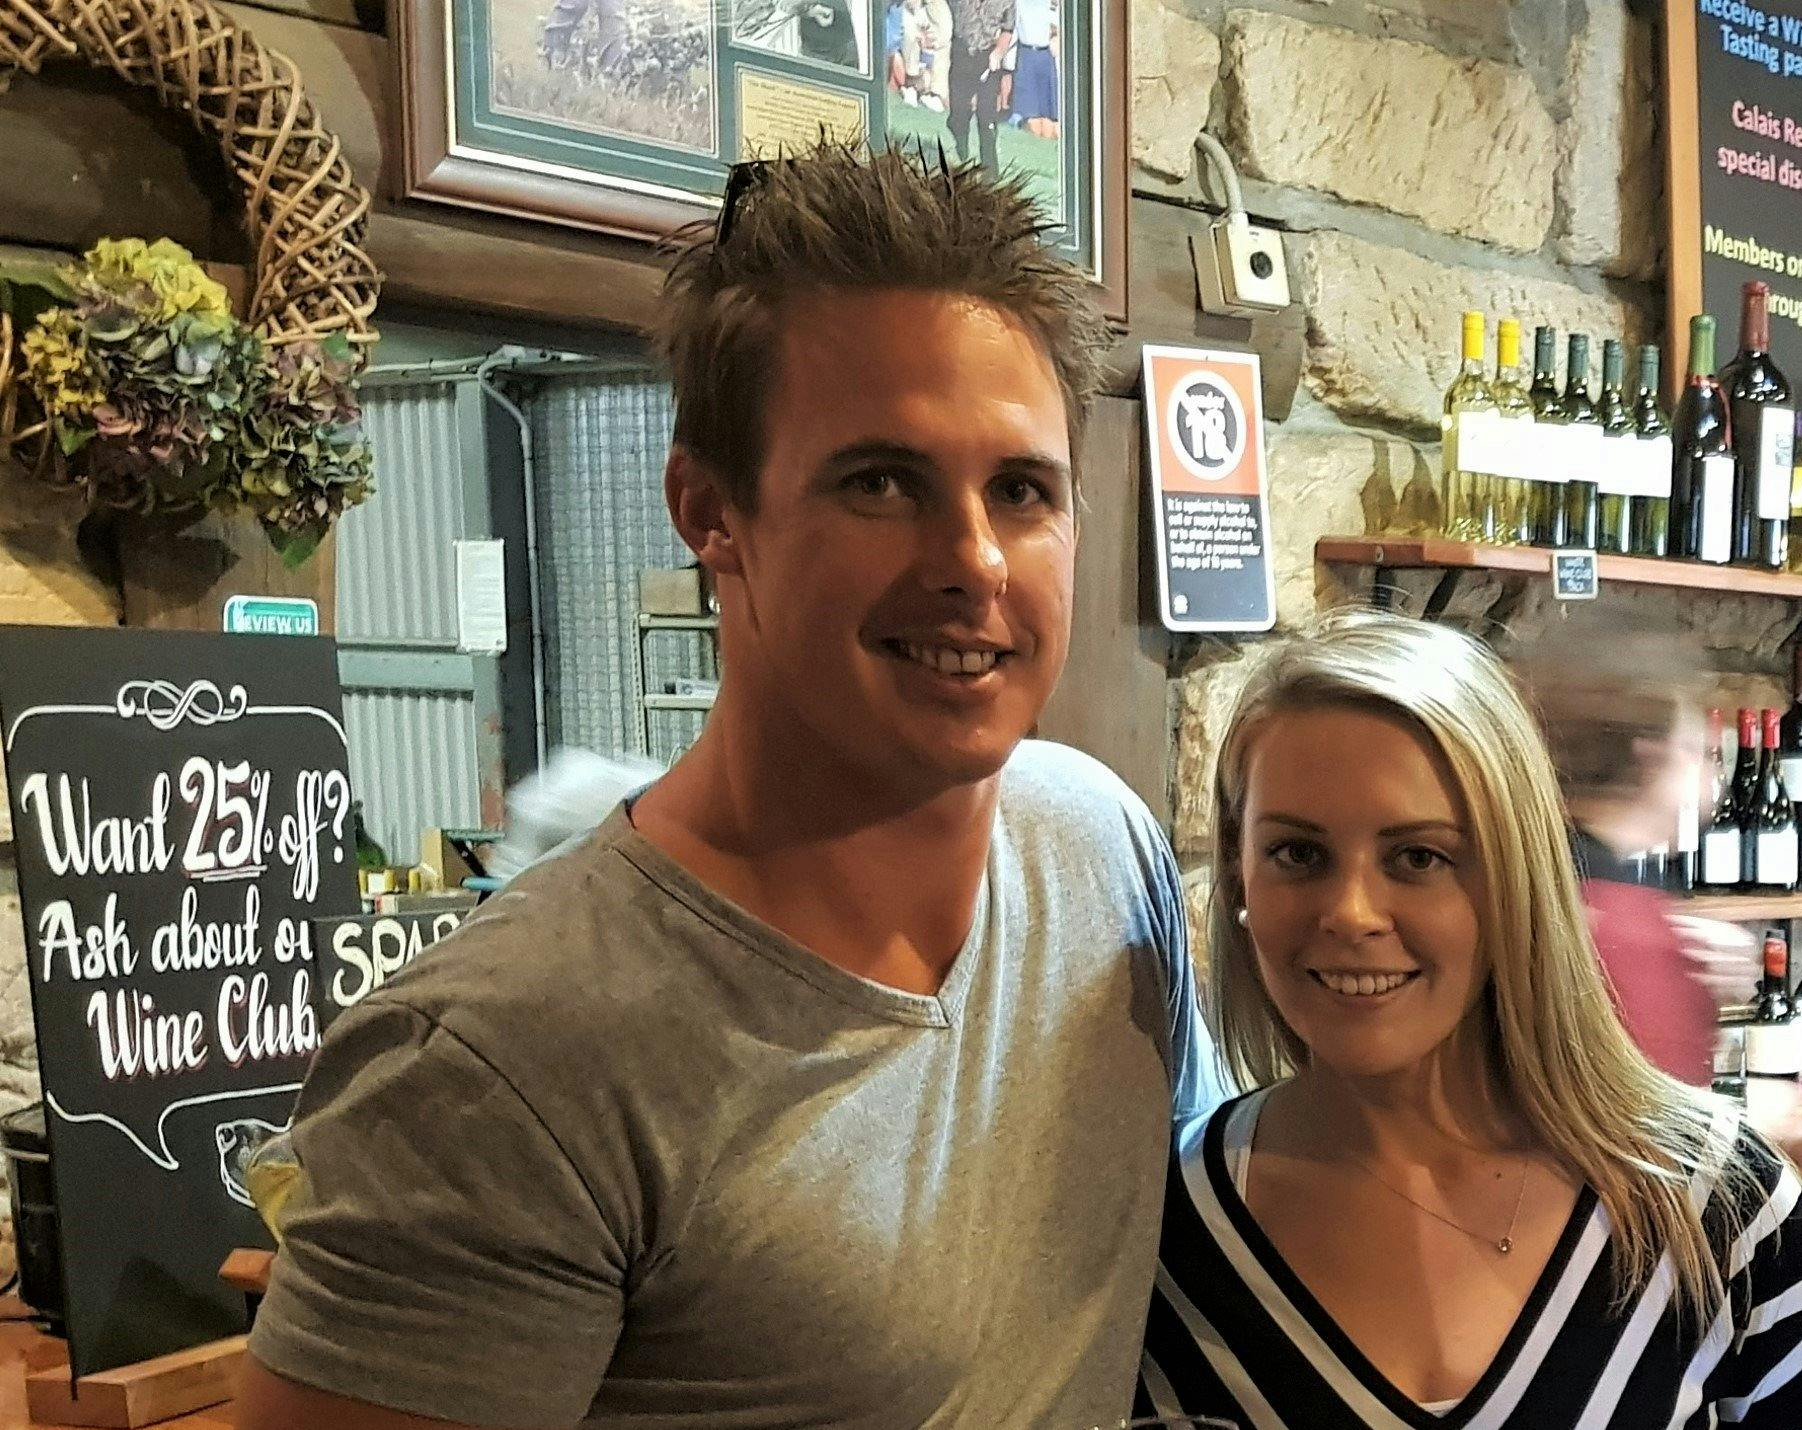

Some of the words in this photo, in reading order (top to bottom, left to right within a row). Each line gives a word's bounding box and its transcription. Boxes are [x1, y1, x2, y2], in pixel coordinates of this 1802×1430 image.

[1720, 24, 1780, 73] Tasting
[1768, 14, 1780, 37] a
[1731, 100, 1782, 140] Calais
[1718, 146, 1776, 182] special
[1704, 224, 1785, 273] Members
[21, 772, 174, 876] Want
[179, 756, 274, 868] 25%
[278, 769, 350, 903] off?
[38, 892, 139, 982] Ask
[151, 884, 262, 974] about
[87, 987, 208, 1081] Wine
